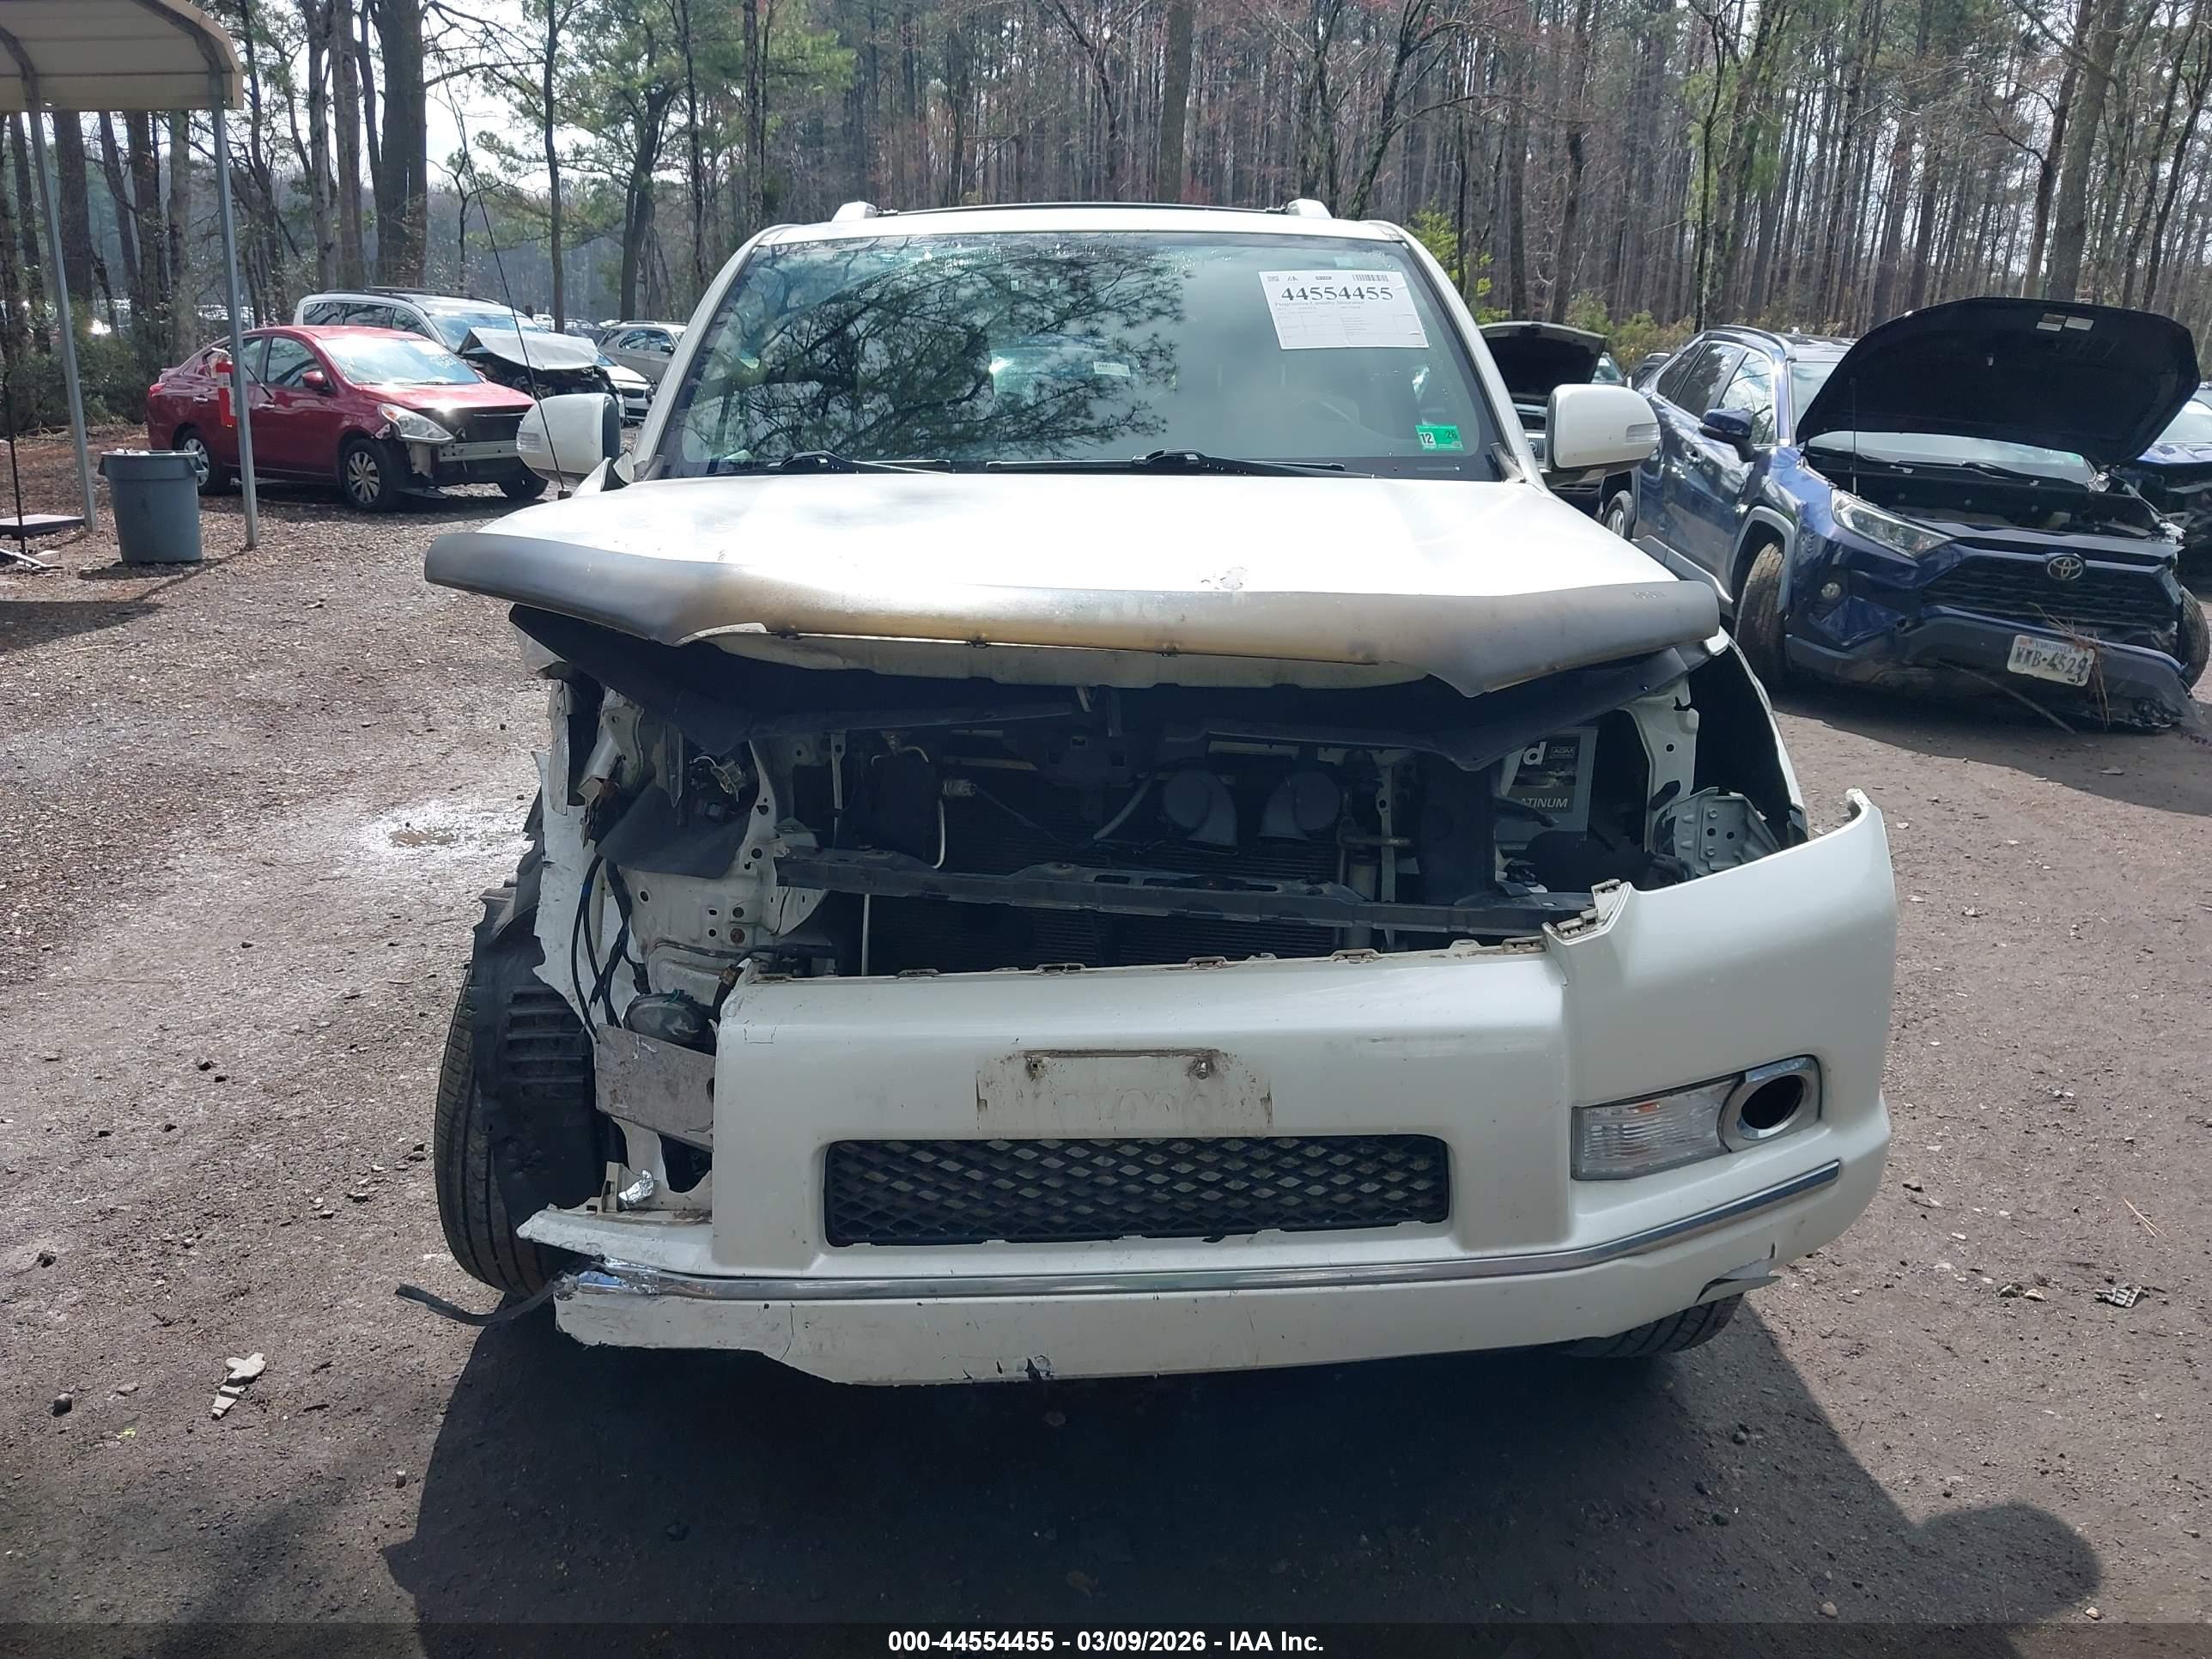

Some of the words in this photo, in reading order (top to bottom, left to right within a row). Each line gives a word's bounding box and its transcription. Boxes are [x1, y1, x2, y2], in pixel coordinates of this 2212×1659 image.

[1281, 286, 1394, 301] 44554455
[1419, 433, 1433, 444] 12
[2034, 641, 2073, 653] VIRGINIA
[1519, 797, 1569, 808] ATINUM
